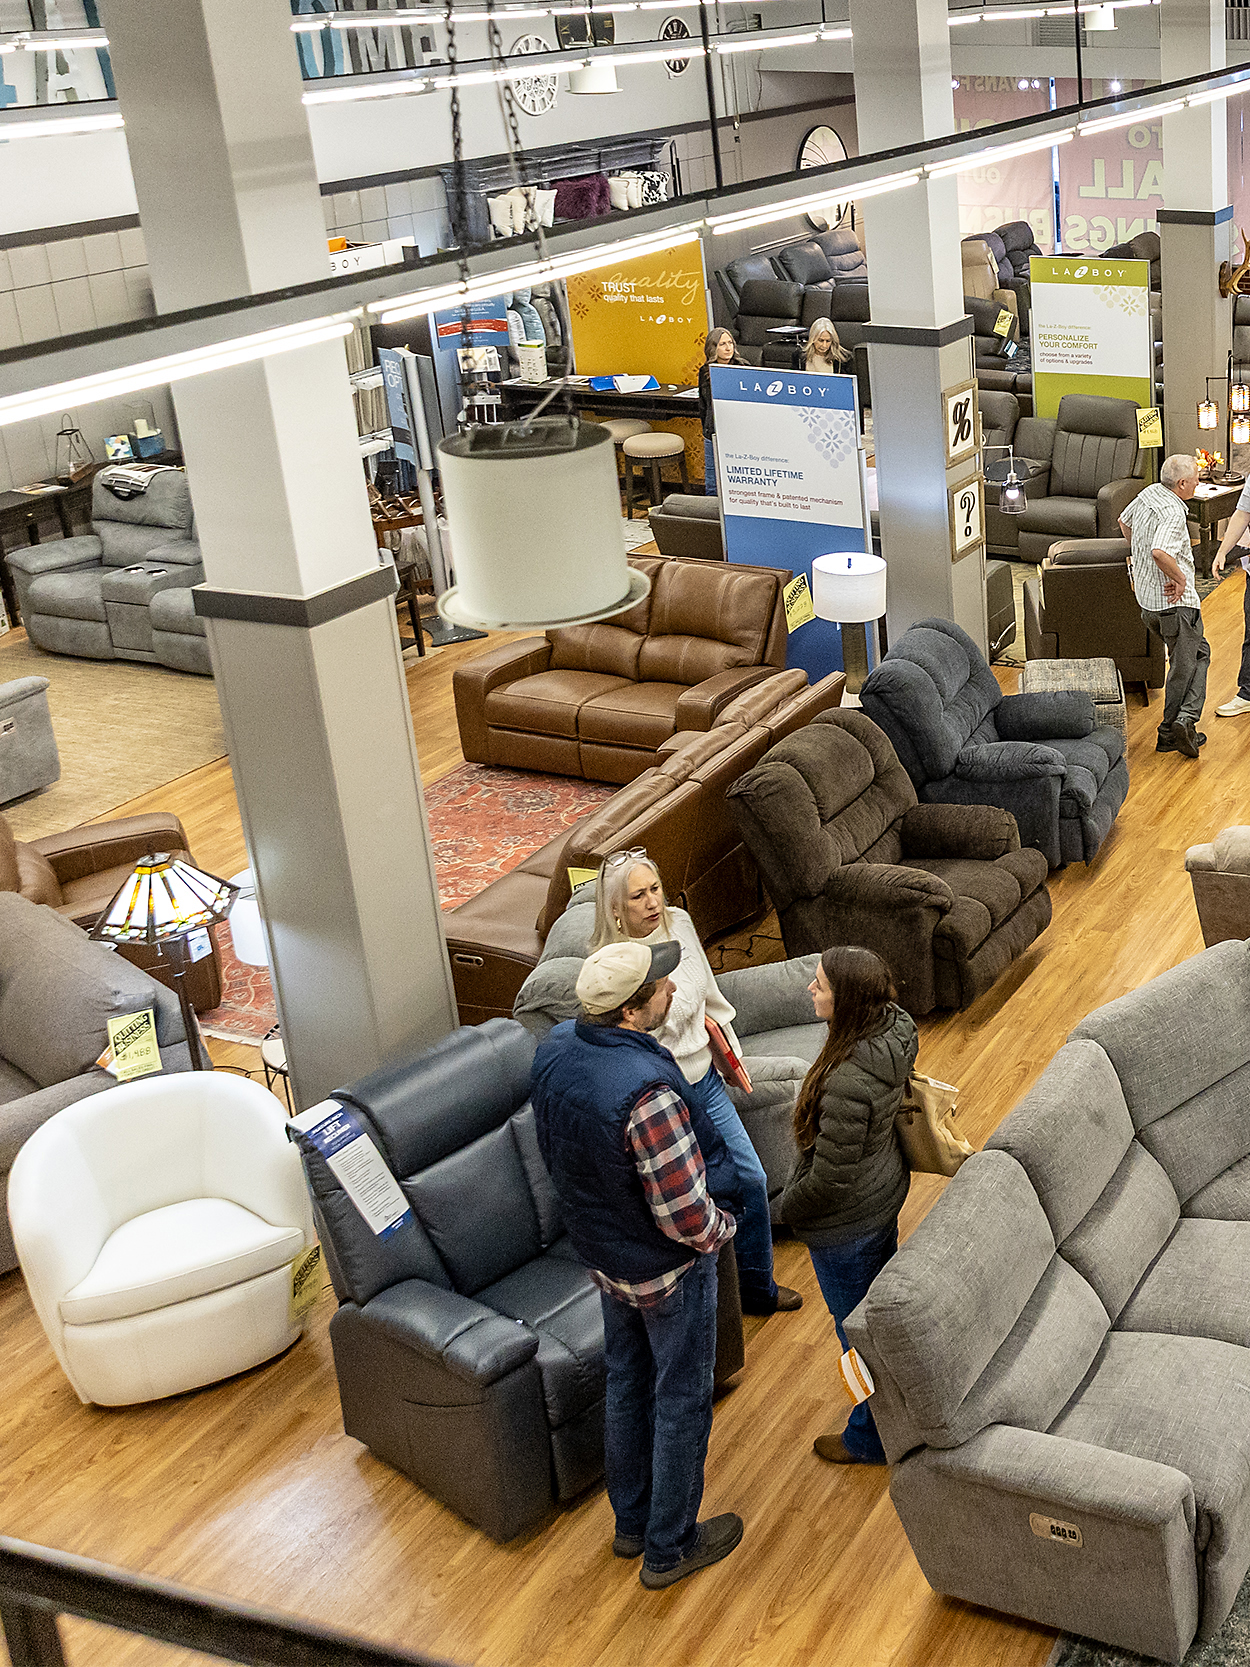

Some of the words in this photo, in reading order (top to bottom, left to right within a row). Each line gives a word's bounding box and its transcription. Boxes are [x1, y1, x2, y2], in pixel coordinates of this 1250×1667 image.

[601, 281, 637, 293] TRUST
[603, 294, 629, 304] quality
[629, 294, 645, 303] that
[646, 295, 665, 304] lasts
[1038, 333, 1090, 342] PERSONALIZE
[1039, 341, 1060, 349] YOUR
[1061, 341, 1099, 350] COMFORT
[952, 397, 972, 447] %
[735, 453, 761, 462] La-Z-Boy
[726, 465, 763, 476] LIMITED
[764, 469, 804, 480] LIFETIME
[727, 475, 778, 487] WARRANTY
[728, 489, 757, 498] strongest
[757, 491, 776, 499] frame
[782, 493, 809, 503] patented
[809, 496, 844, 506] mechanism
[738, 498, 759, 507] quality
[760, 499, 778, 507] that's
[778, 501, 792, 509] built
[800, 503, 811, 511] last
[960, 490, 976, 538] ?
[114, 1014, 148, 1042] QUITTING
[115, 1022, 151, 1052] BUSINESS
[322, 1120, 342, 1136] LIFT
